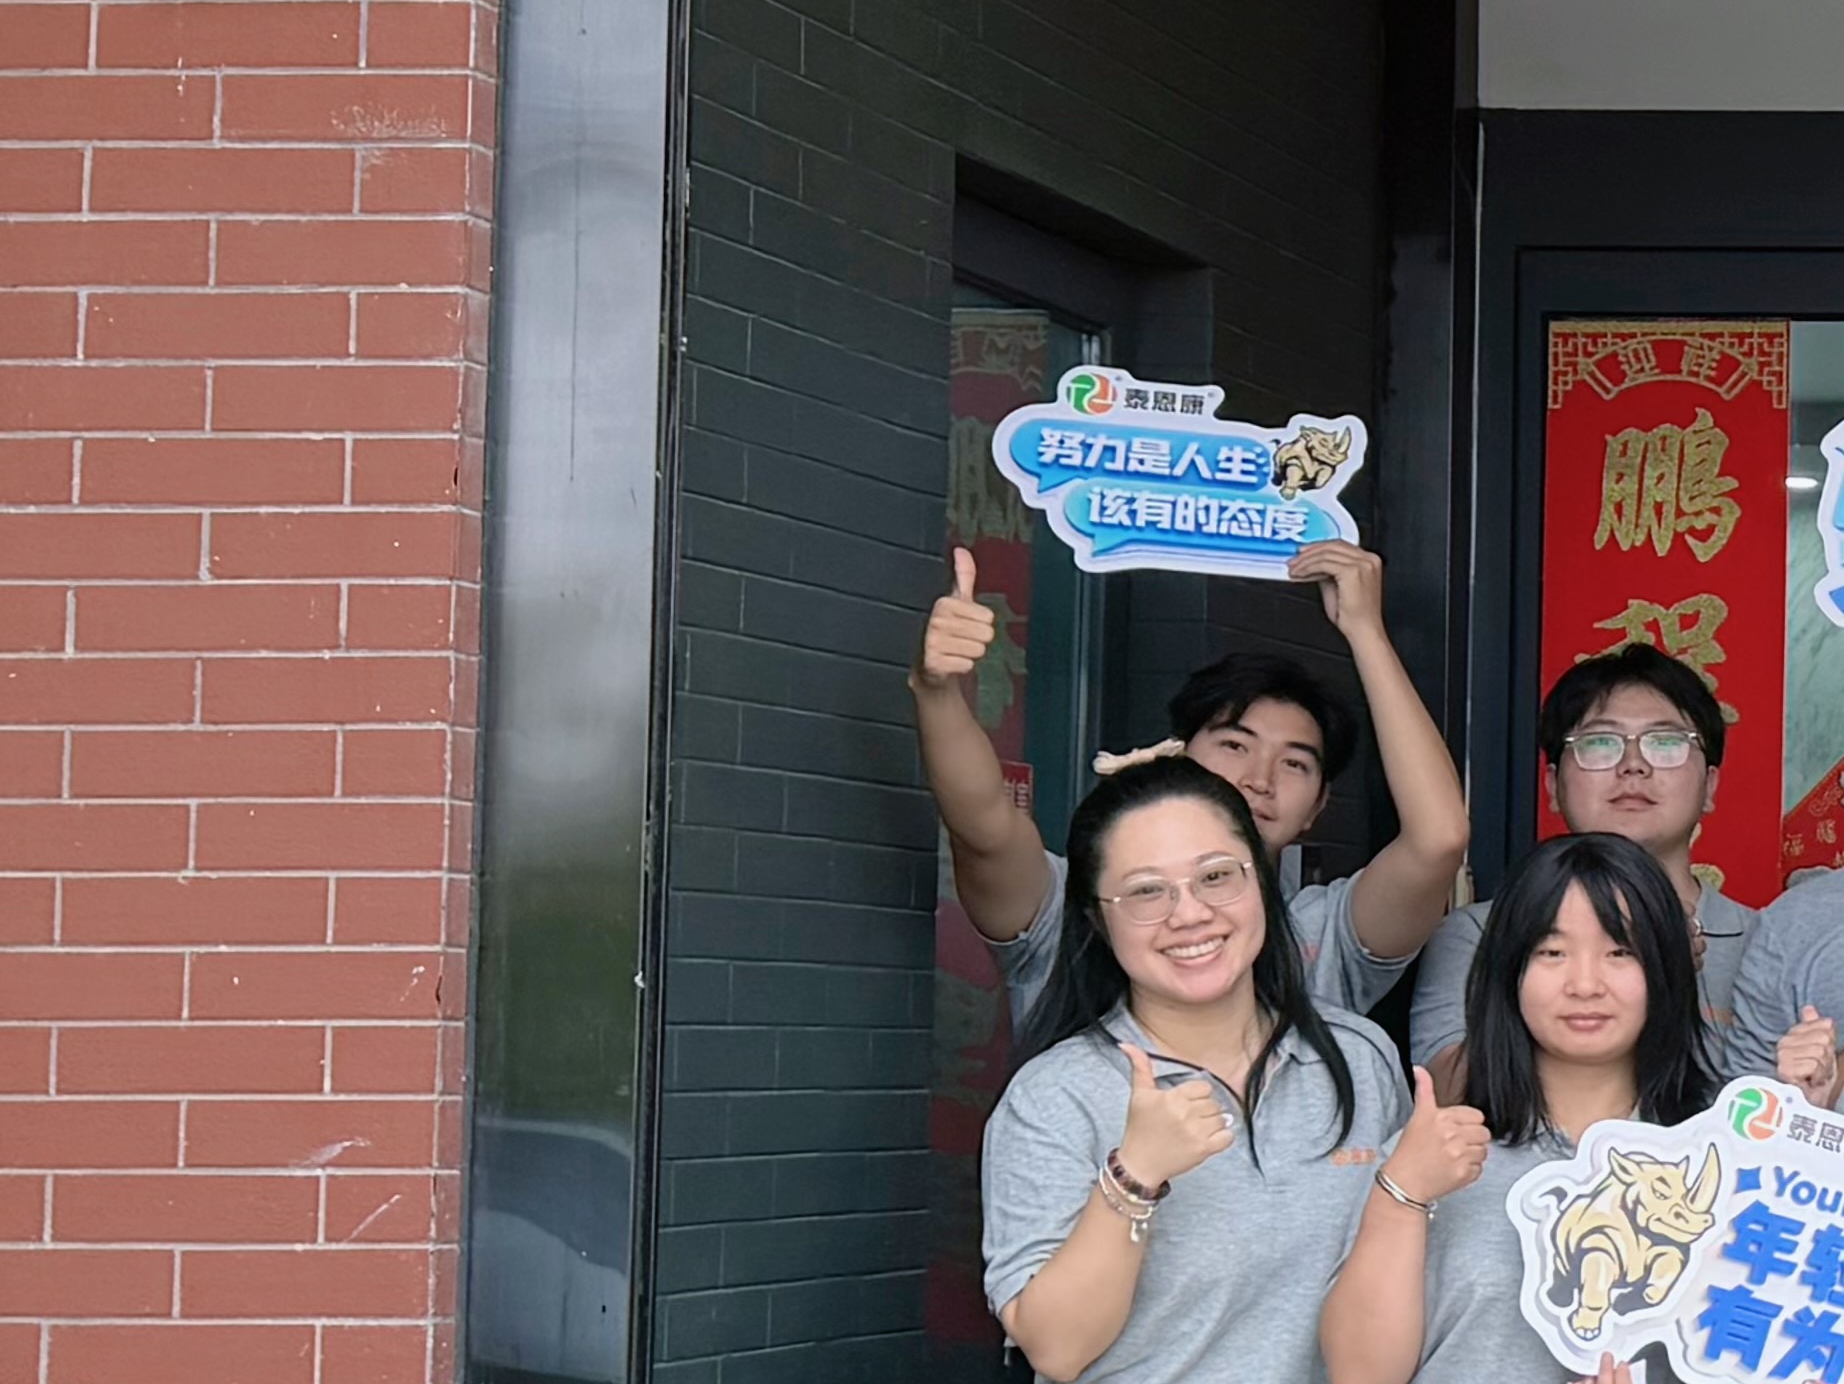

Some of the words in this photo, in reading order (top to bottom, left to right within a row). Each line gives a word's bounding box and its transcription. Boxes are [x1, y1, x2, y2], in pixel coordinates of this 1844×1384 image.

[1123, 386, 1206, 416] 泰恩康
[1036, 425, 1262, 485] 努力是人生
[1086, 485, 1310, 543] 该有的态度
